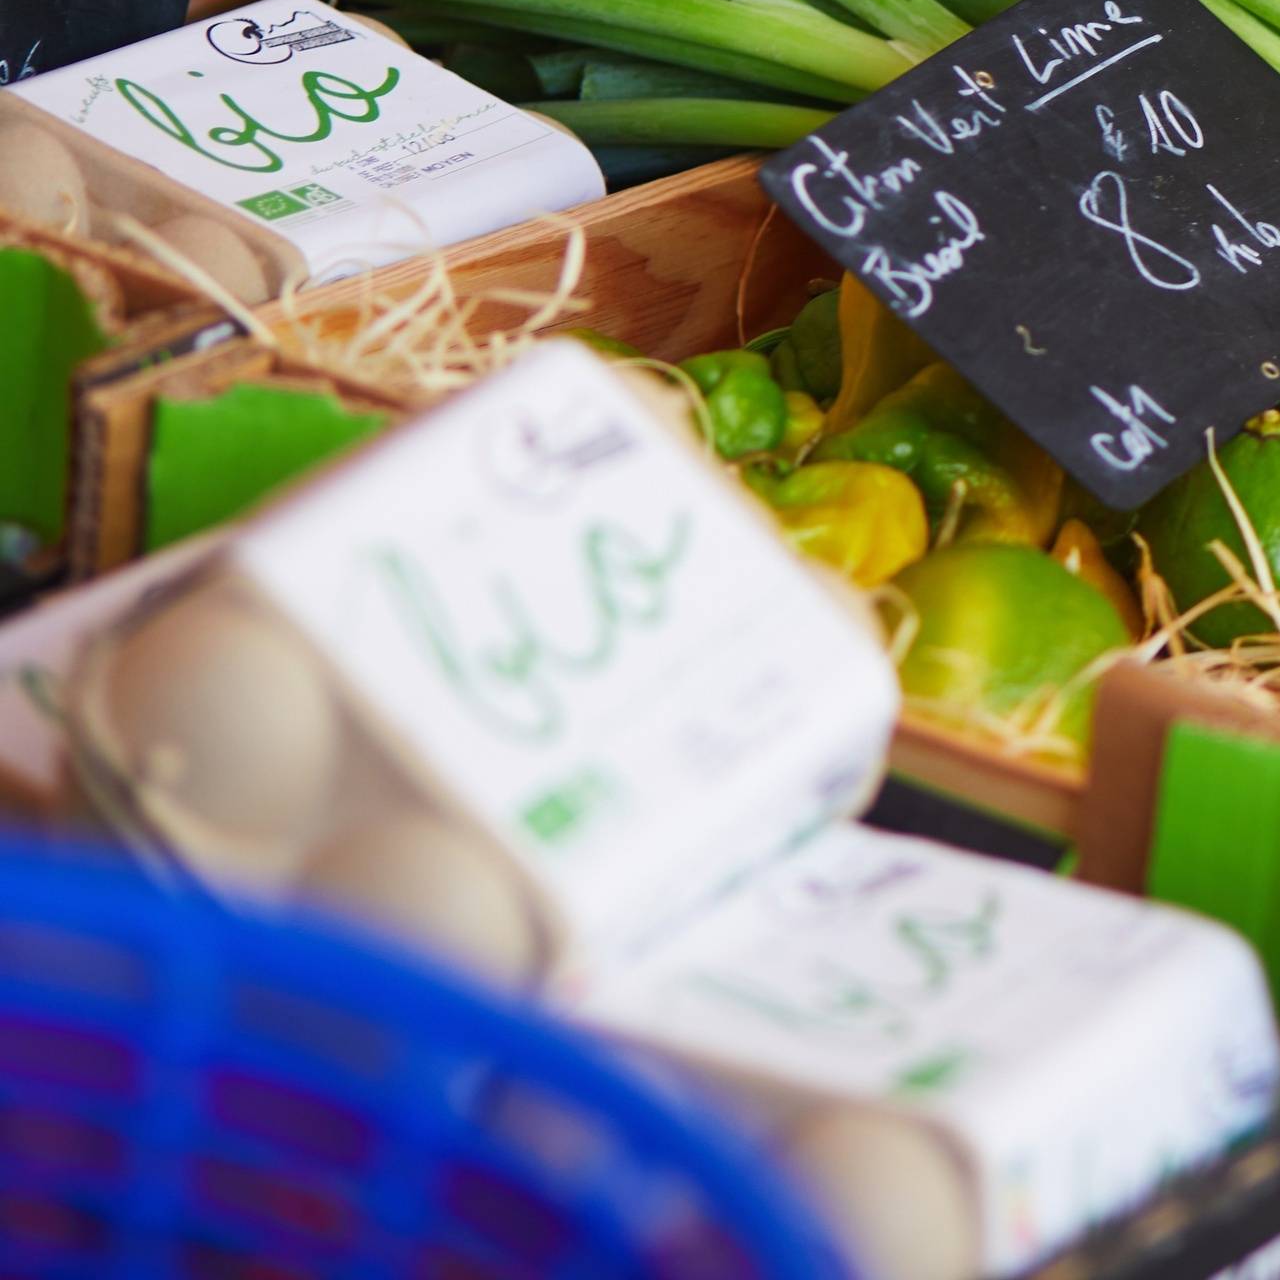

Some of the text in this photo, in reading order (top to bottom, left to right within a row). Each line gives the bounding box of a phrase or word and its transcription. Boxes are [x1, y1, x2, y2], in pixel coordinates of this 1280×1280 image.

[115, 67, 400, 172] bio
[897, 64, 1006, 155] Vert
[1012, 0, 1143, 85] Lime
[421, 150, 476, 175] MOYEN
